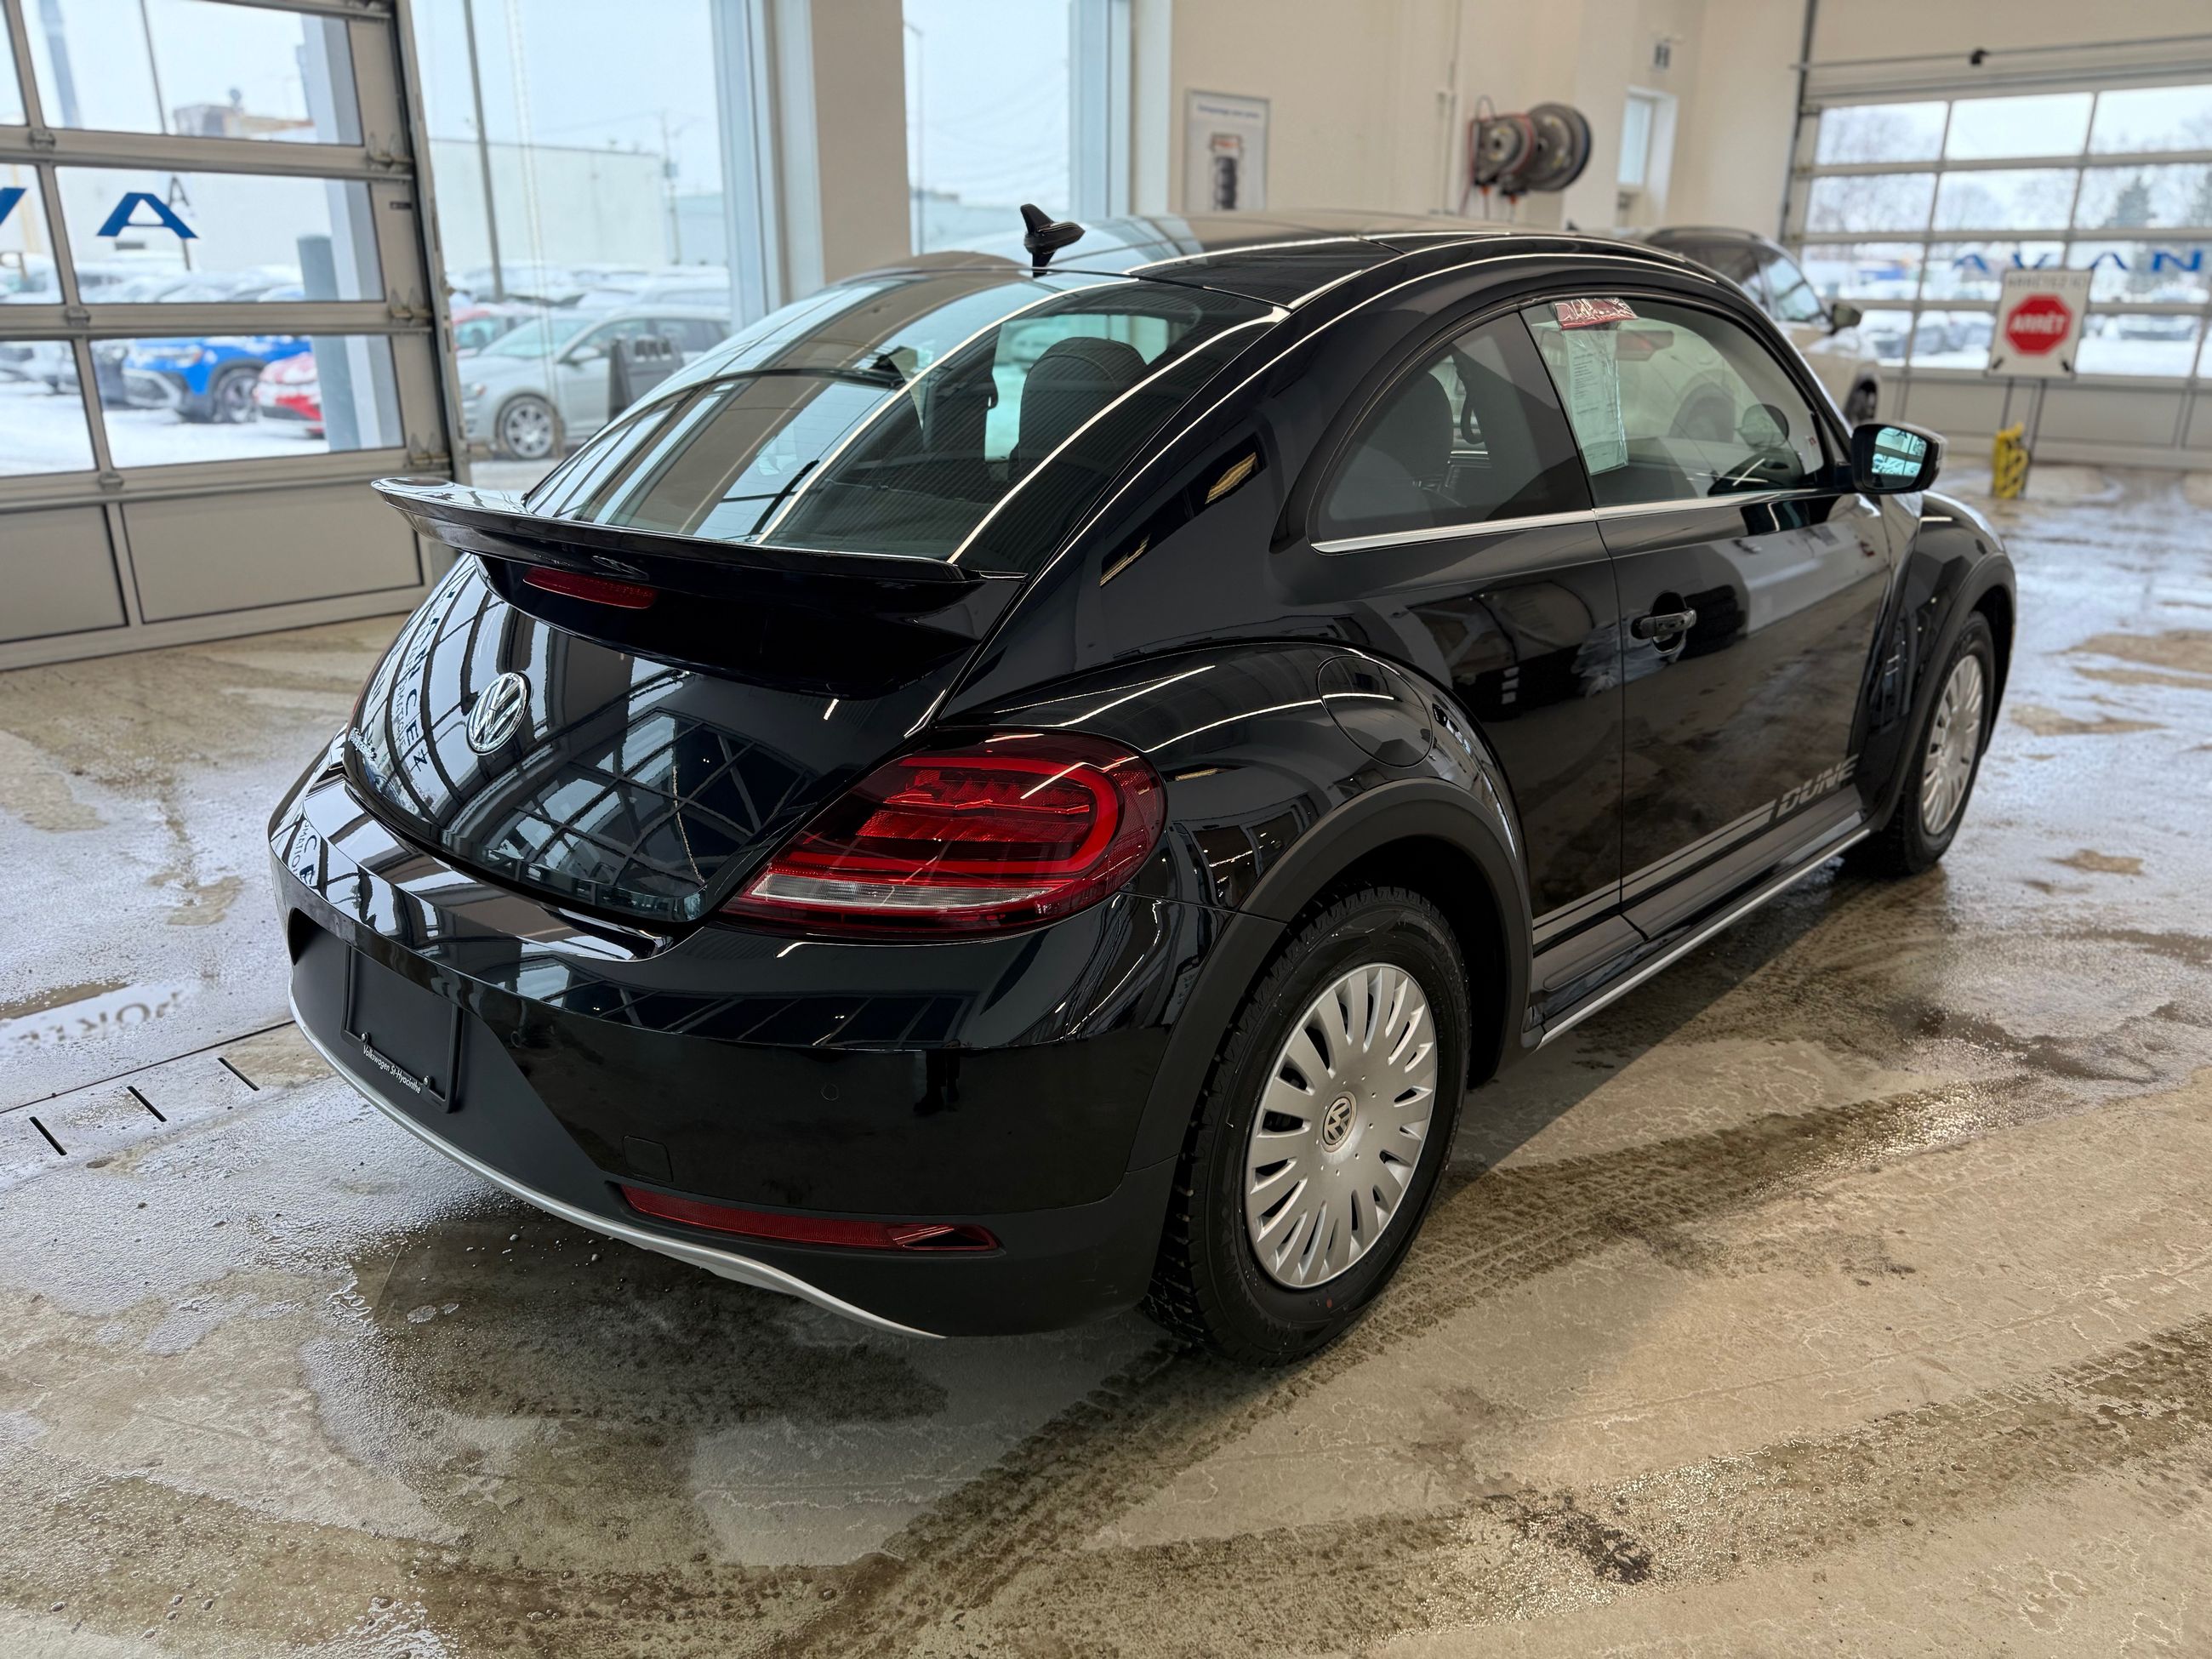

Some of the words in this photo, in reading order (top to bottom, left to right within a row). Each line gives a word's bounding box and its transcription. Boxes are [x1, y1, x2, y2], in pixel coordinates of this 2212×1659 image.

[1776, 753, 1859, 818] DUNE
[362, 1043, 391, 1072] Volkswagen
[390, 1063, 422, 1095] St-Hyacinthe
